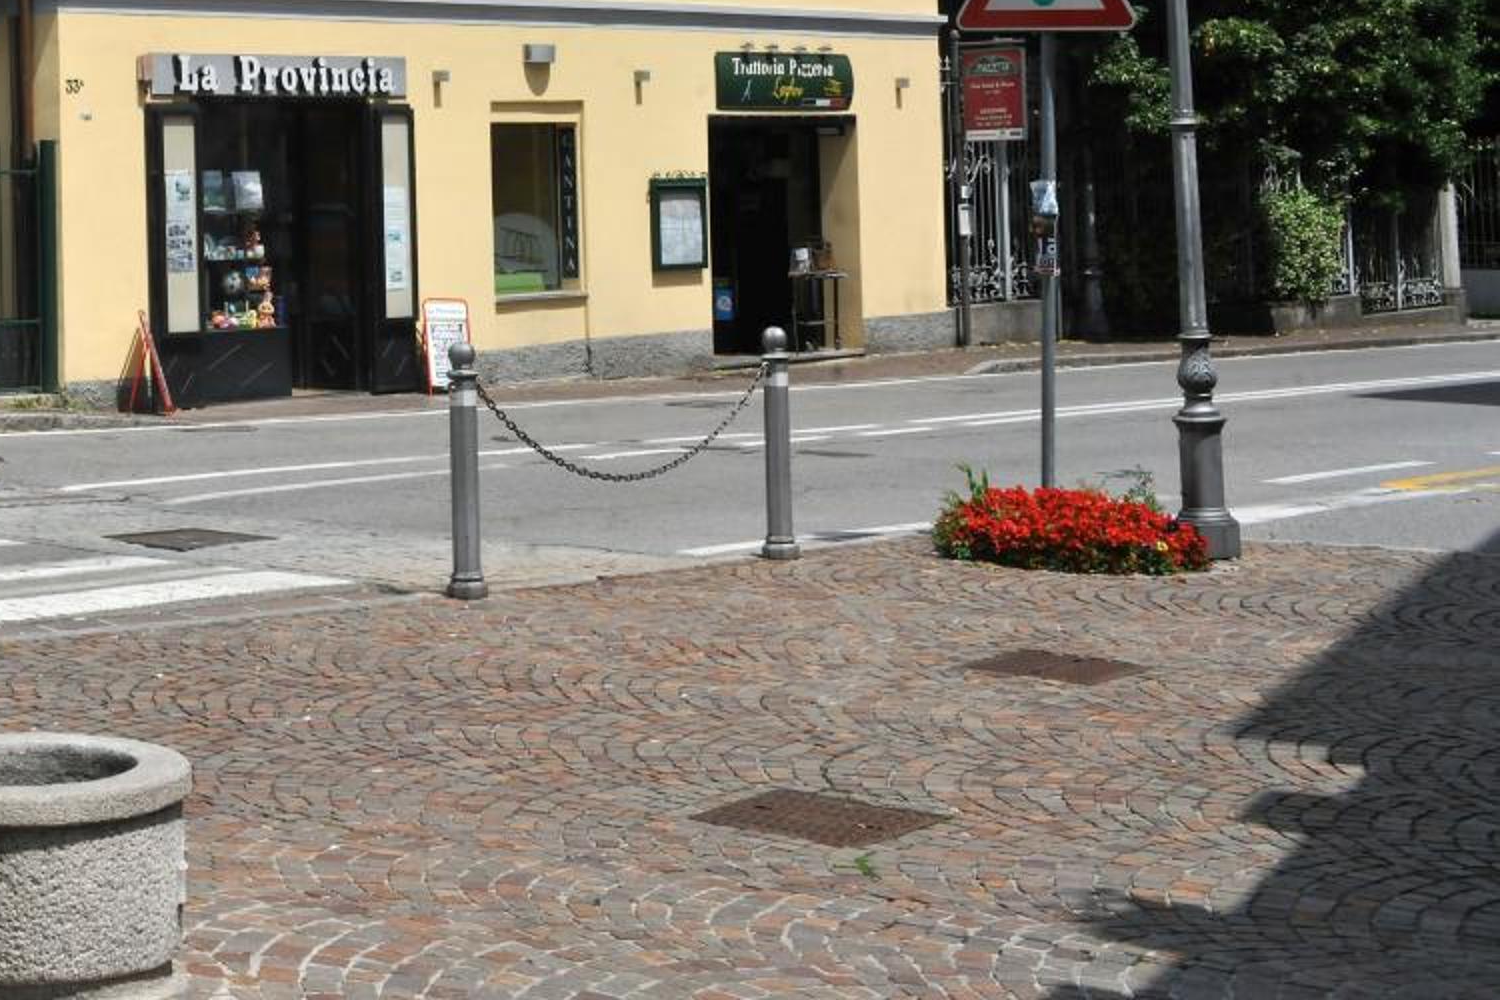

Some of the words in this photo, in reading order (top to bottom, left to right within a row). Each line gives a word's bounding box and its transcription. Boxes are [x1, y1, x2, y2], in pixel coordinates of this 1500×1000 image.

[177, 55, 219, 91] La
[238, 55, 397, 94] Provincia
[731, 57, 786, 76] Trattoria
[788, 57, 835, 78] Pizzeria
